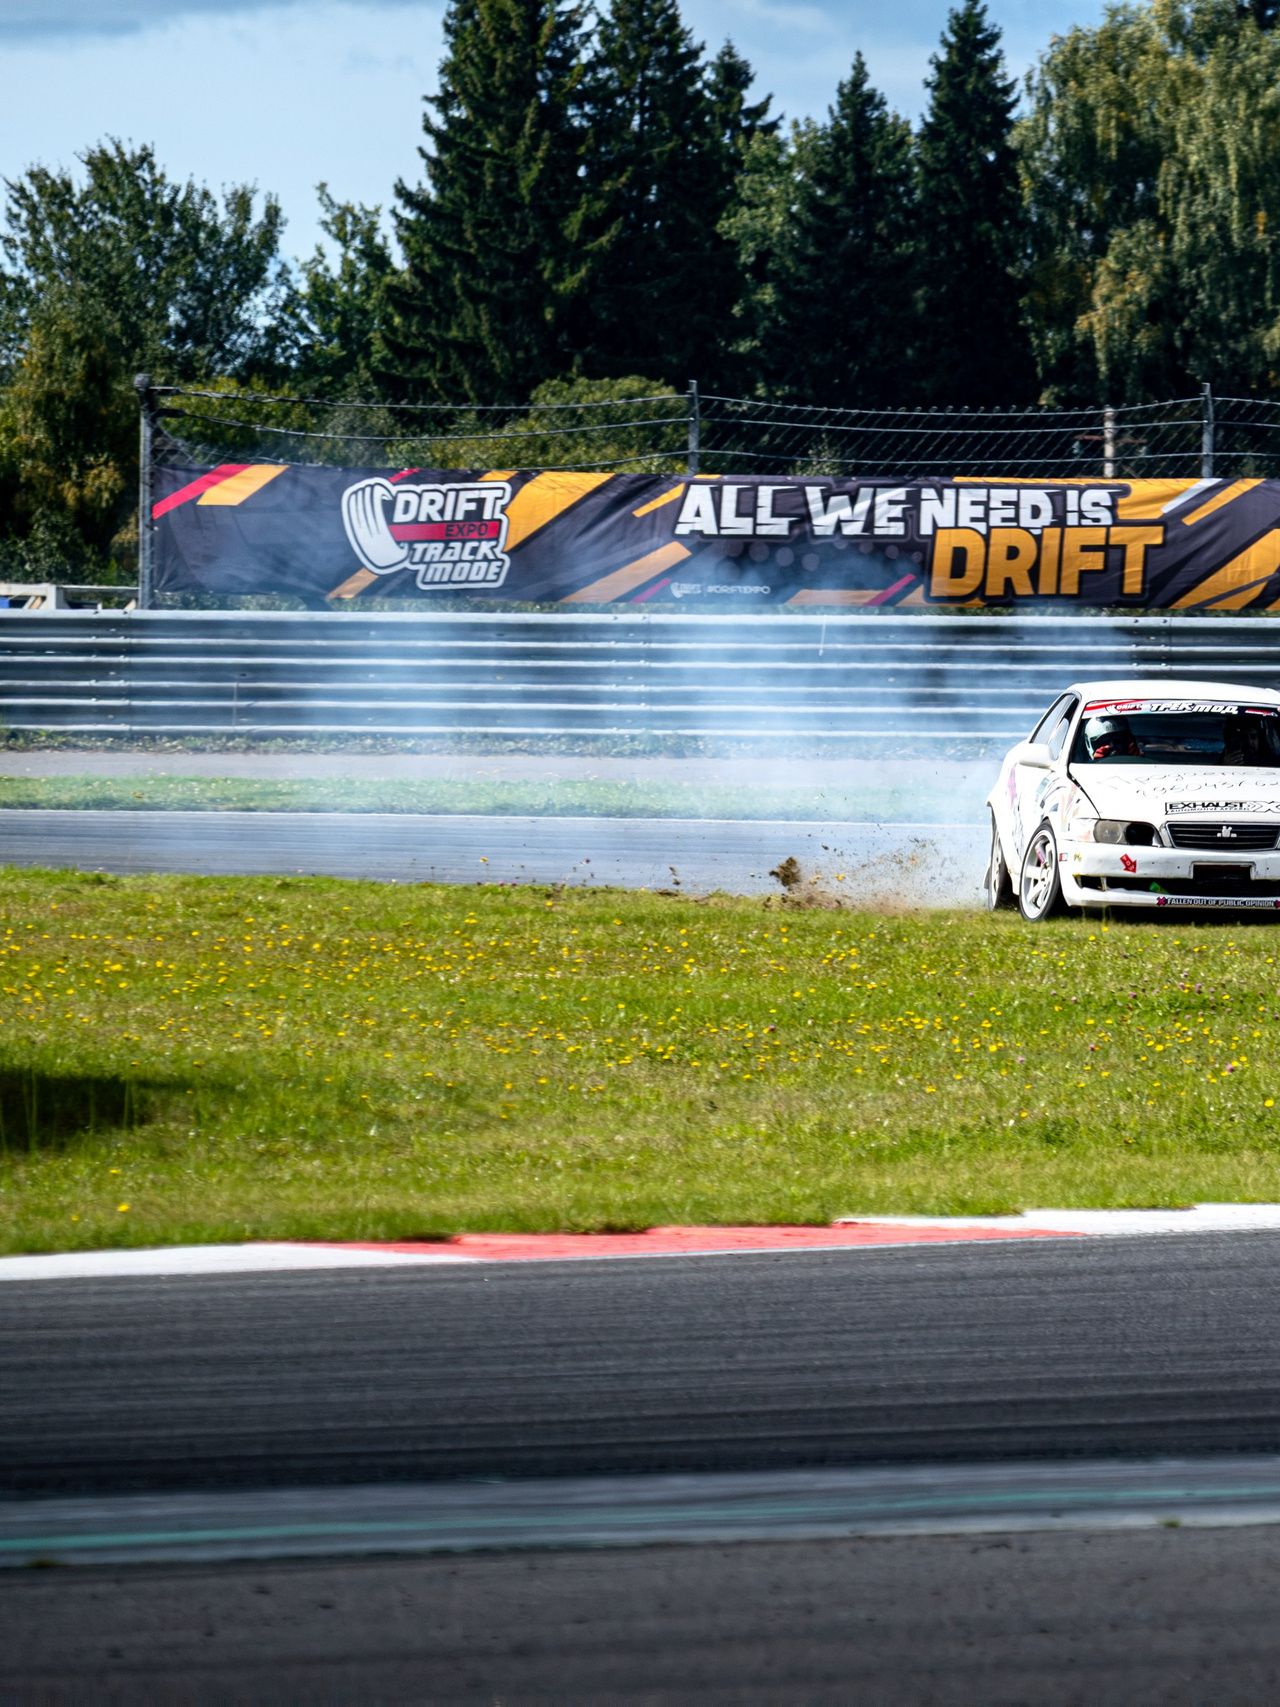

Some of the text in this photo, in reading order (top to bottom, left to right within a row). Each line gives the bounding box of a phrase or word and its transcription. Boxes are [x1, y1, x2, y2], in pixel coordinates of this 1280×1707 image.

[392, 489, 502, 522] DRIFT
[674, 484, 1118, 536] ALL WE NEED IS
[444, 522, 489, 538] EXPO
[411, 541, 499, 561] TRACK
[929, 526, 1164, 597] DRIFT
[424, 562, 502, 583] MODE
[1168, 801, 1245, 809] EXHAUST
[1167, 897, 1192, 906] FALLEN
[1193, 898, 1207, 906] OUT
[1218, 899, 1244, 907] PUBLIC
[1245, 900, 1275, 908] OPINION
